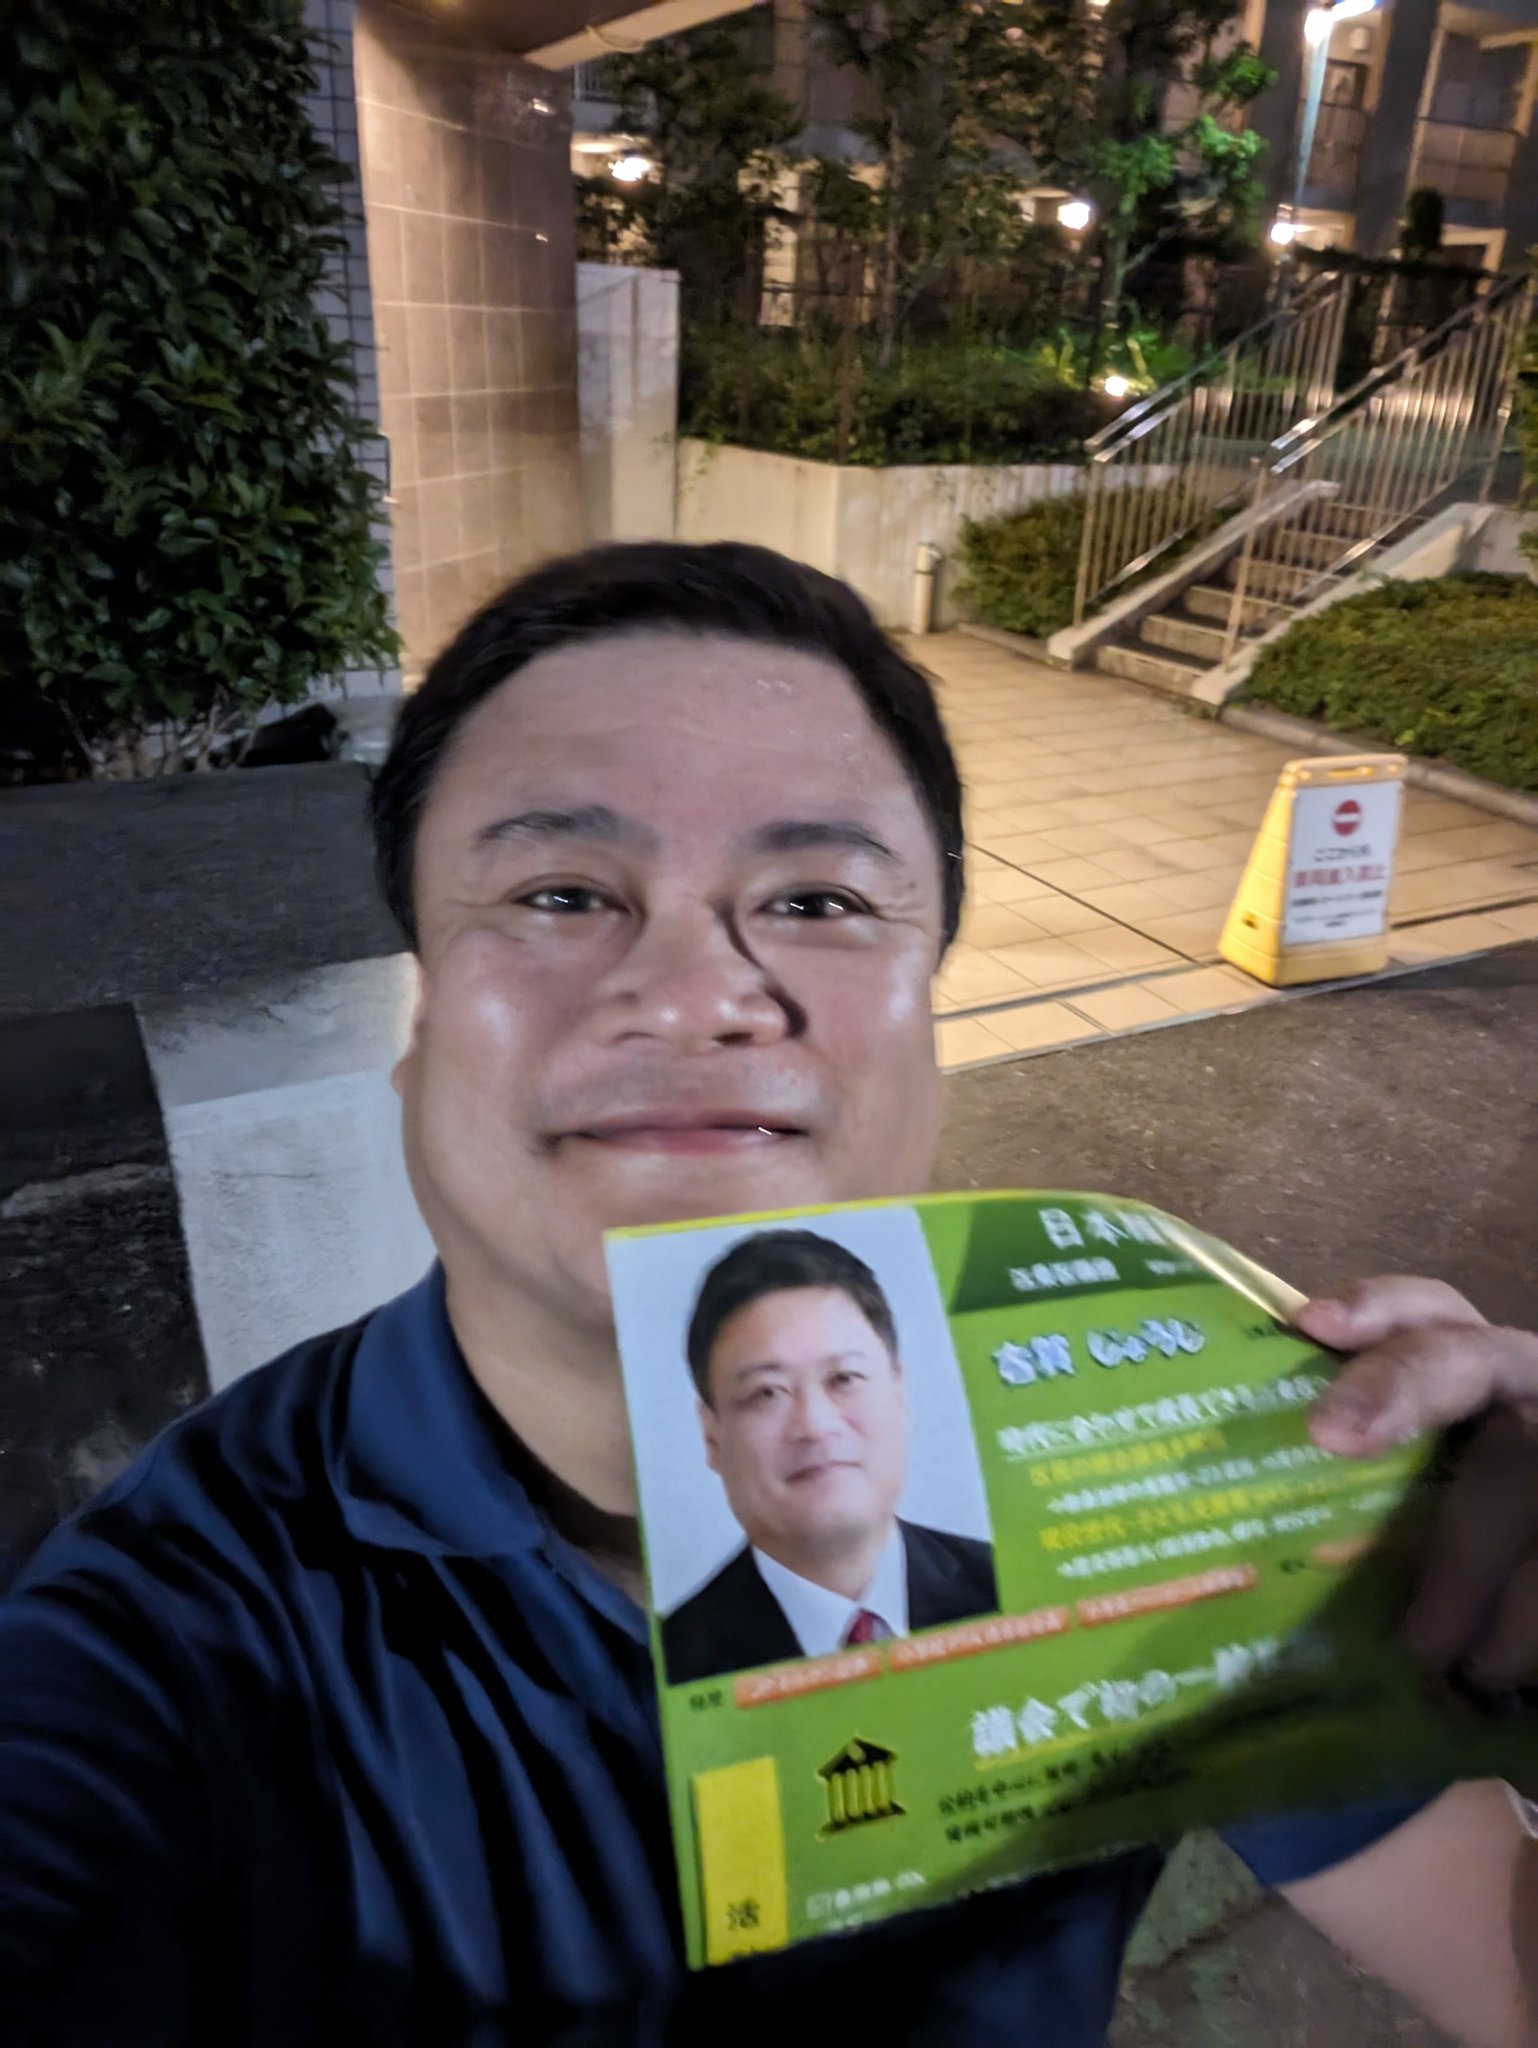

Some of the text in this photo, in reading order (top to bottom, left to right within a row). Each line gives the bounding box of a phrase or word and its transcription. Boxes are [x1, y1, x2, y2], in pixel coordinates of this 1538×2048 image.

[971, 1622, 1335, 1757] 議会で初の一般
